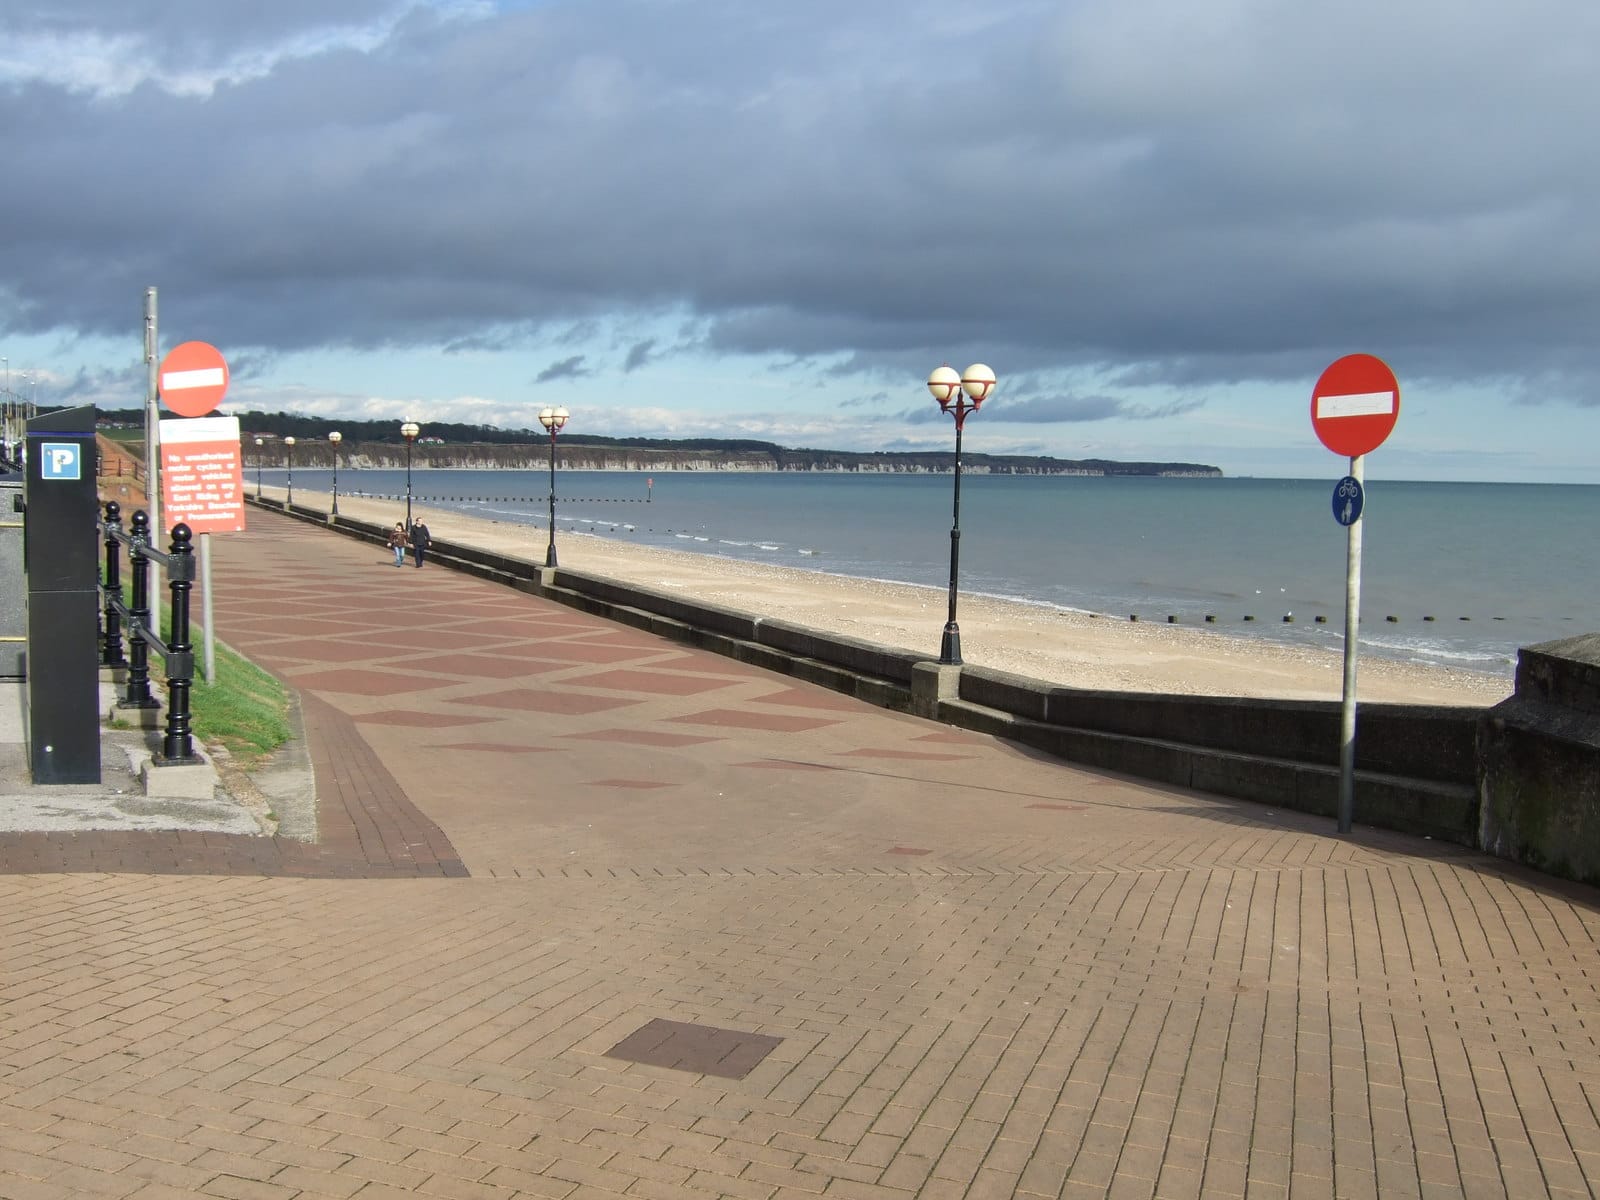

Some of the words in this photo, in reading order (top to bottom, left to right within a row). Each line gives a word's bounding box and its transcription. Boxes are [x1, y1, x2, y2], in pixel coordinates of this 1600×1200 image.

[52, 449, 74, 473] P
[196, 463, 222, 472] cycles
[201, 472, 232, 480] vehicles
[170, 484, 202, 492] allowed
[221, 483, 236, 491] any
[195, 493, 220, 501] Riding
[167, 503, 203, 511] Yorkshire
[187, 512, 235, 520] Promenades
